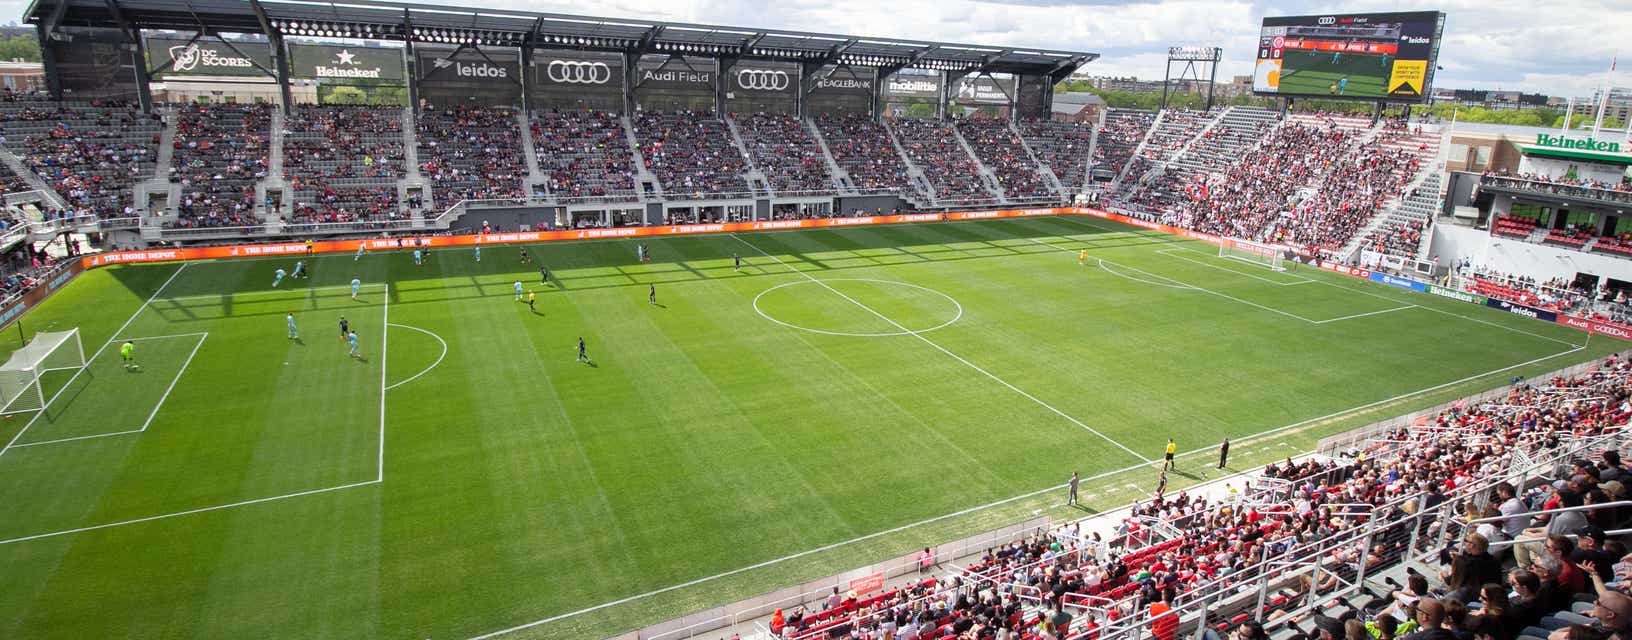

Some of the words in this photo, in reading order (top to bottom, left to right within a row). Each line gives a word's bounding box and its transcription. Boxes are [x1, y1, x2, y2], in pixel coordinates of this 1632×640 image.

[1408, 36, 1430, 44] leidos
[201, 49, 217, 57] DC
[202, 57, 252, 67] SCORES
[315, 66, 379, 78] Heineken
[457, 62, 507, 78] leidos
[643, 70, 676, 81] Audi
[678, 71, 709, 83] Field
[1536, 133, 1620, 153] Heineken
[1430, 286, 1473, 302] Heineken
[1510, 306, 1538, 318] leidos
[1567, 318, 1589, 329] Audi
